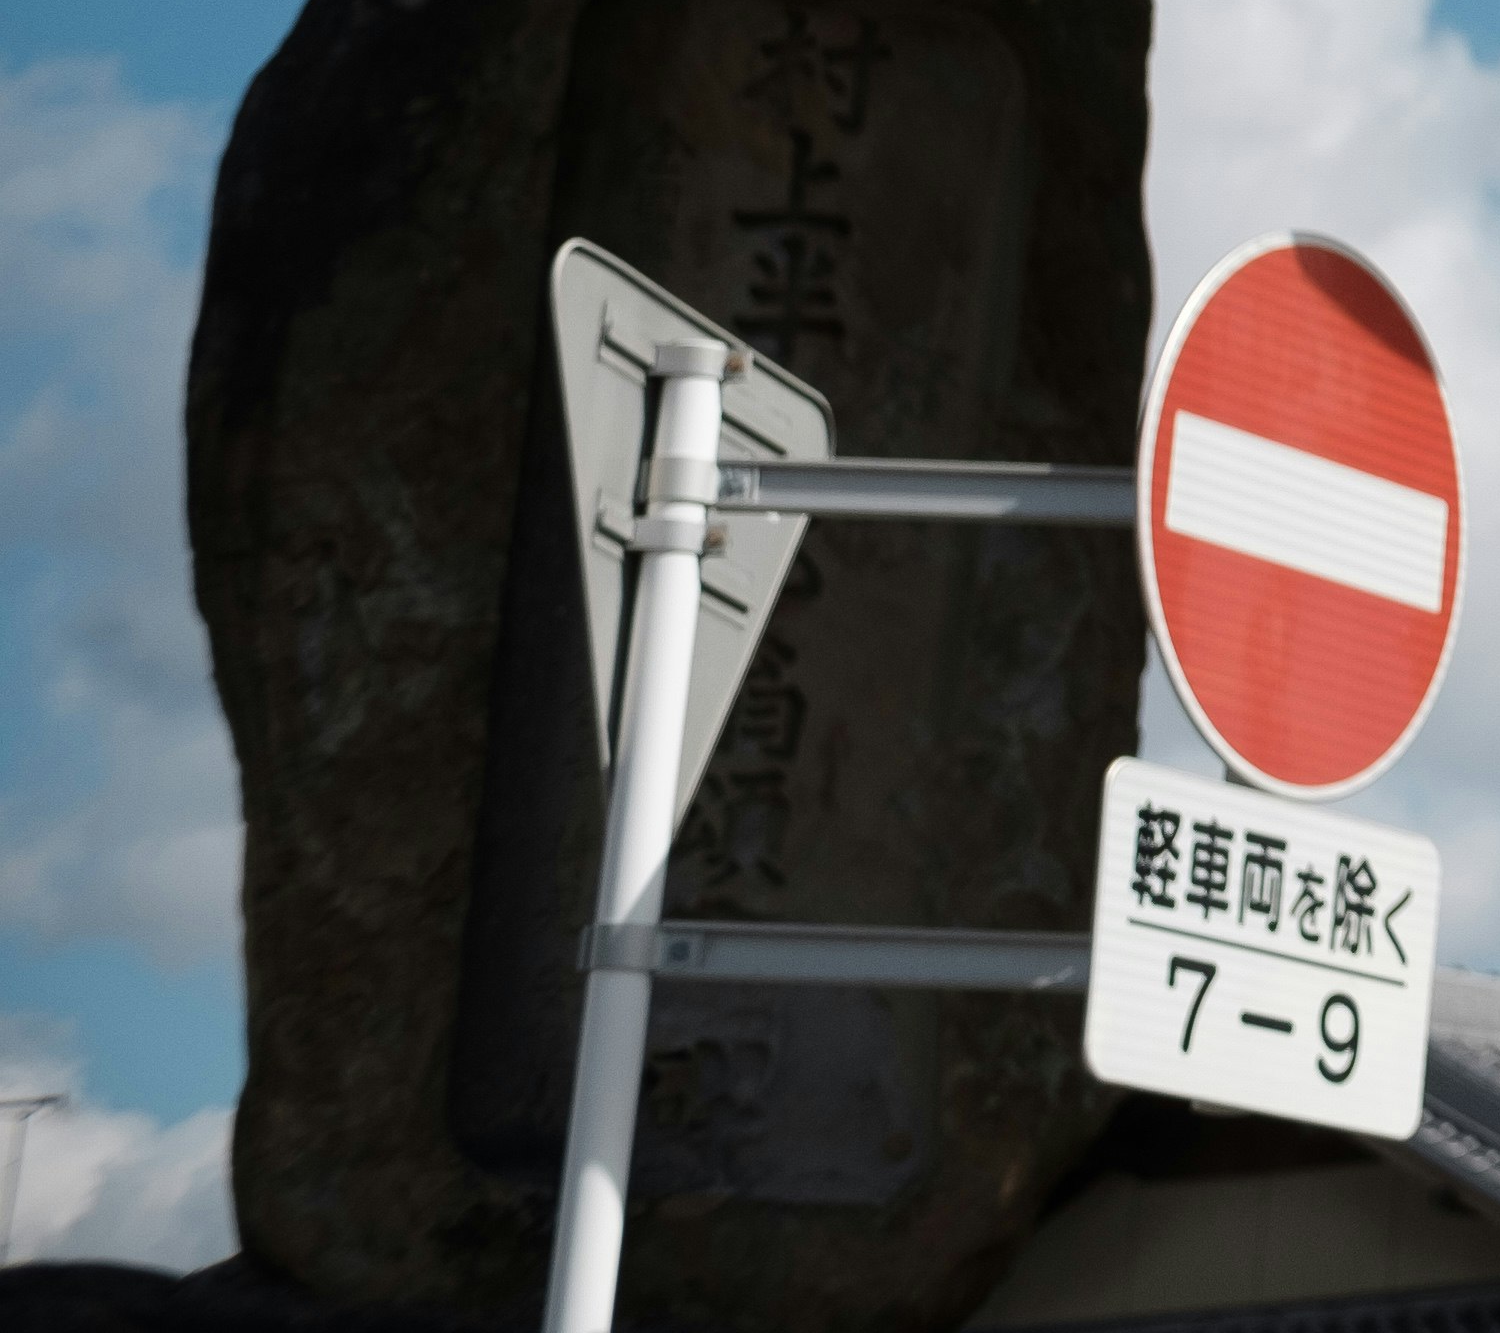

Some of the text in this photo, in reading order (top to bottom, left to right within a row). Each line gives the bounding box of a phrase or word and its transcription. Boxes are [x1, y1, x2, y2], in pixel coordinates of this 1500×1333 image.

[1131, 799, 1412, 965] 軽車両を除く
[1168, 955, 1360, 1083] 7-9
